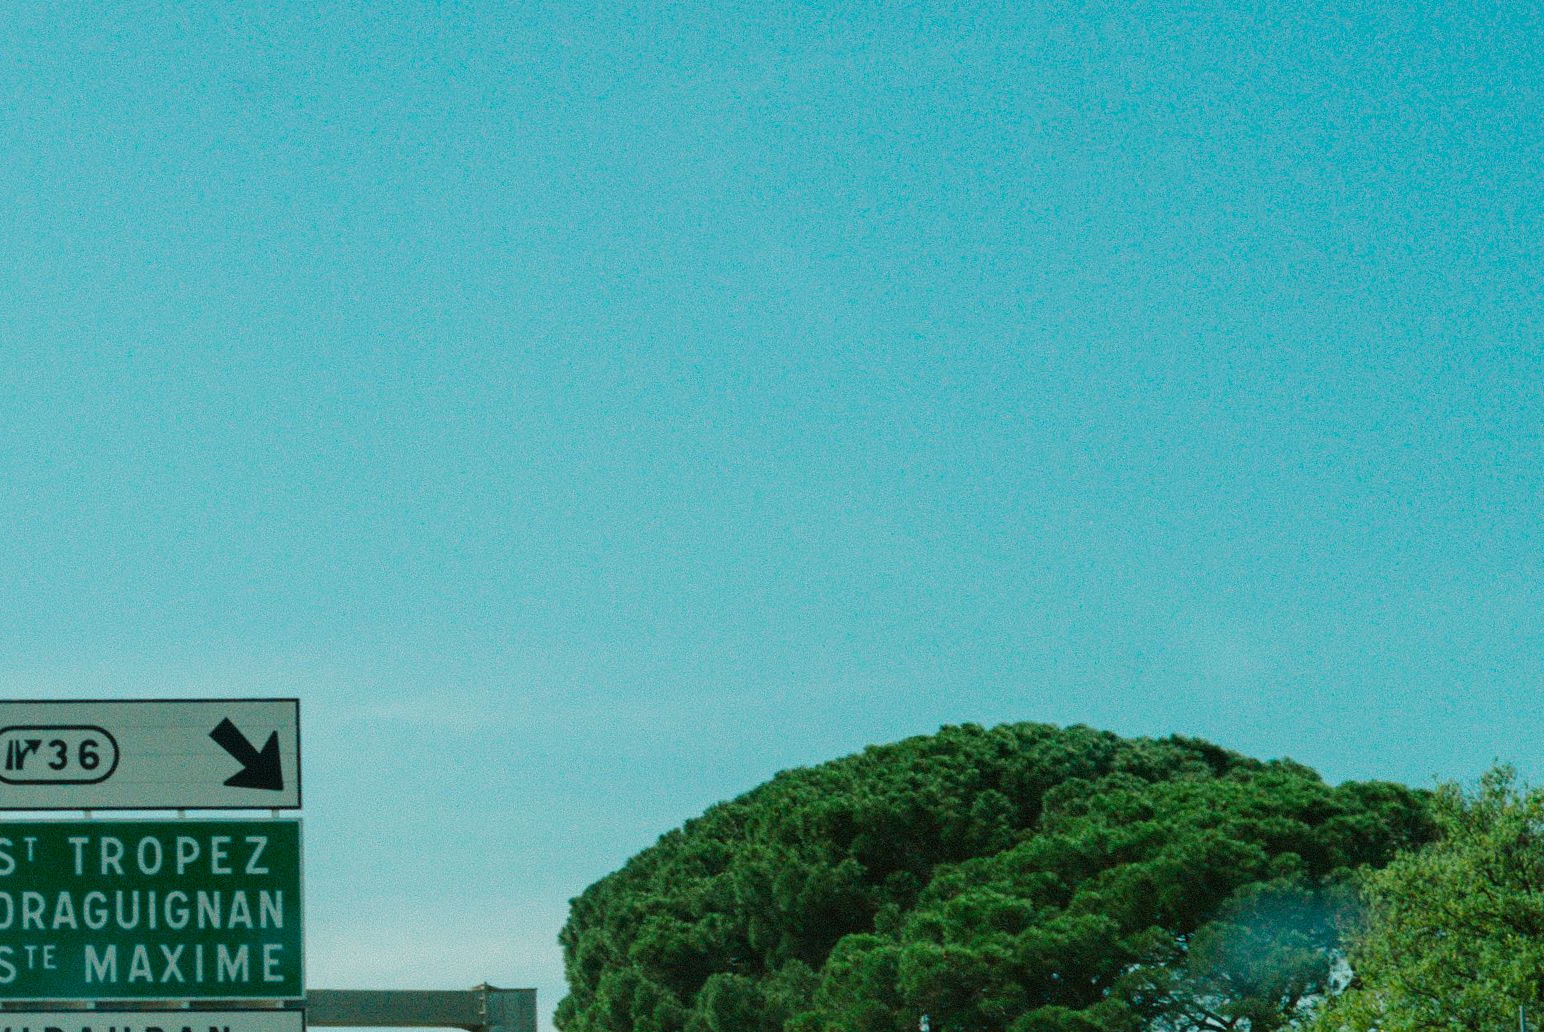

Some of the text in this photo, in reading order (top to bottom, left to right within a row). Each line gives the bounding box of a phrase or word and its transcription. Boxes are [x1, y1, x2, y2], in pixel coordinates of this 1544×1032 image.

[48, 738, 100, 771] 36
[68, 835, 269, 876] TROPEZ
[84, 943, 284, 983] MAXIME
